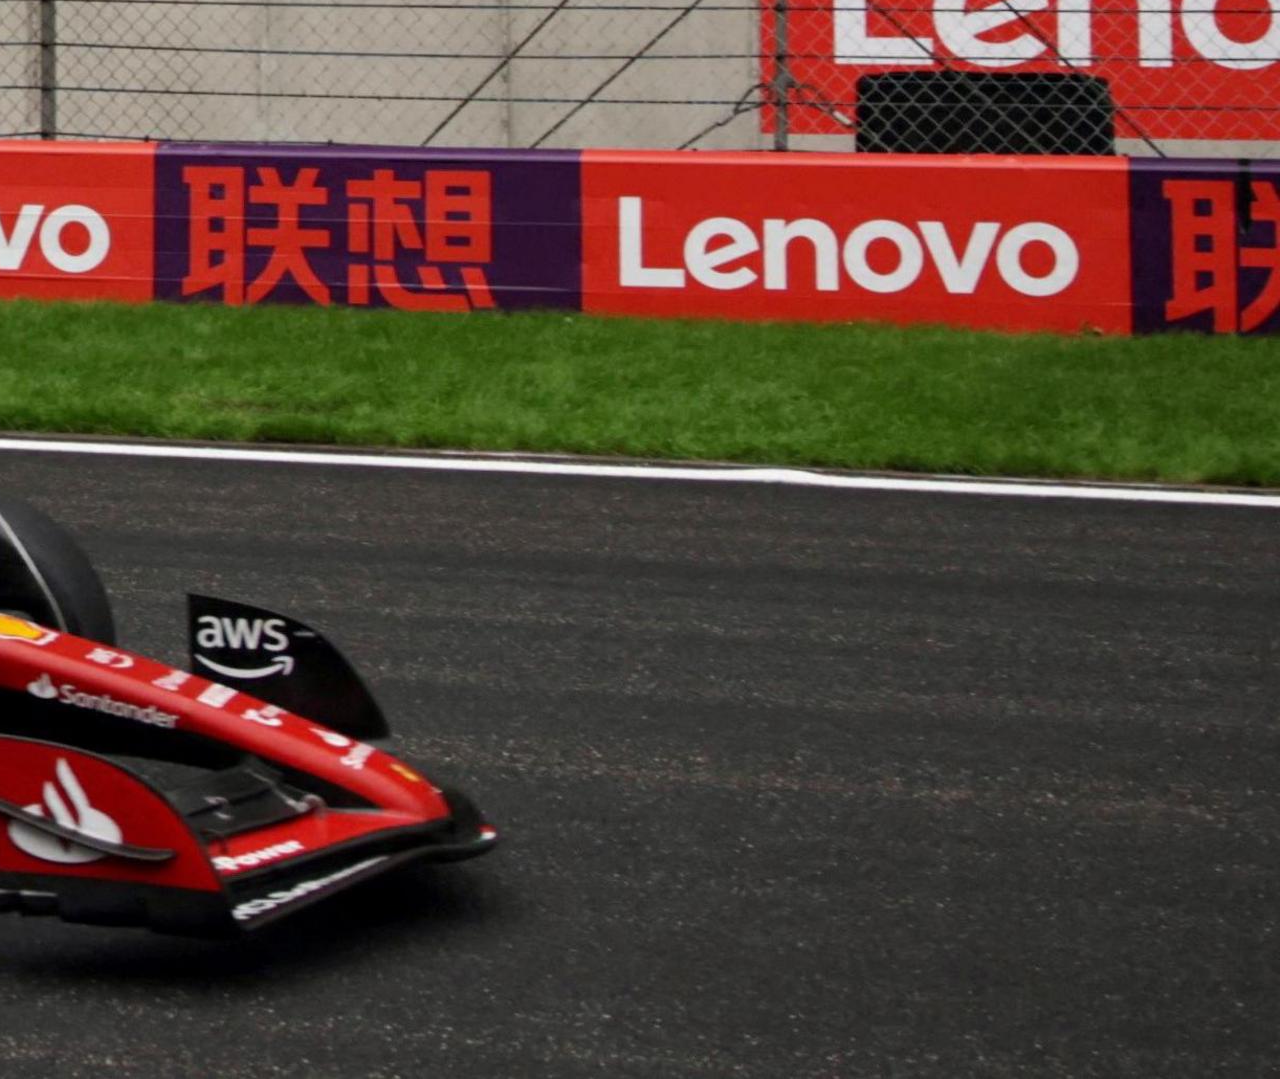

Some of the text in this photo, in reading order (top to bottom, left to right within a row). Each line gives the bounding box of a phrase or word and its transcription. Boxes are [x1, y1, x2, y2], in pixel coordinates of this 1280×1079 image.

[181, 166, 497, 313] 联想
[618, 196, 1079, 297] Lenovo
[196, 615, 290, 652] aws
[57, 684, 181, 728] Santander
